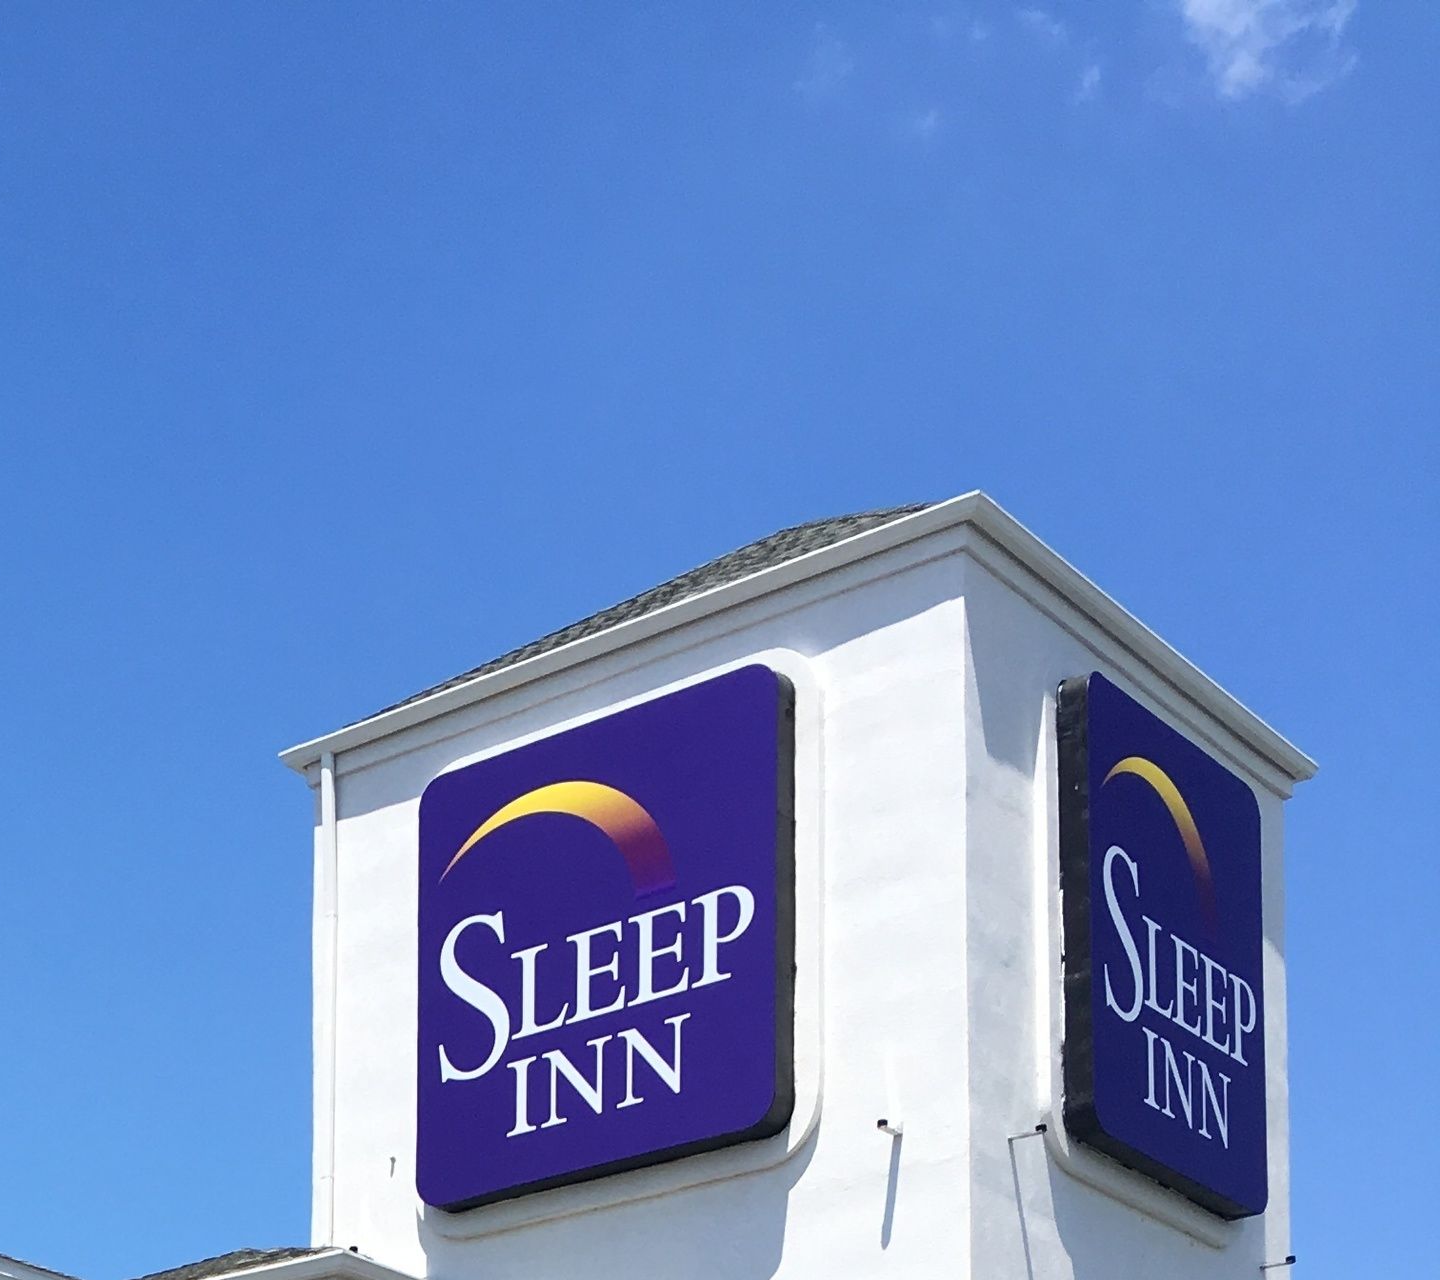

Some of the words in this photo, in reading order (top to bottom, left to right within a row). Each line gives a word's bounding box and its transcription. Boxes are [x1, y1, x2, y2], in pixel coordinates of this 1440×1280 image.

[438, 884, 756, 1083] SLEEP
[1102, 845, 1257, 1067] SLEEP
[506, 1013, 691, 1138] INN
[1142, 1026, 1232, 1149] INN
